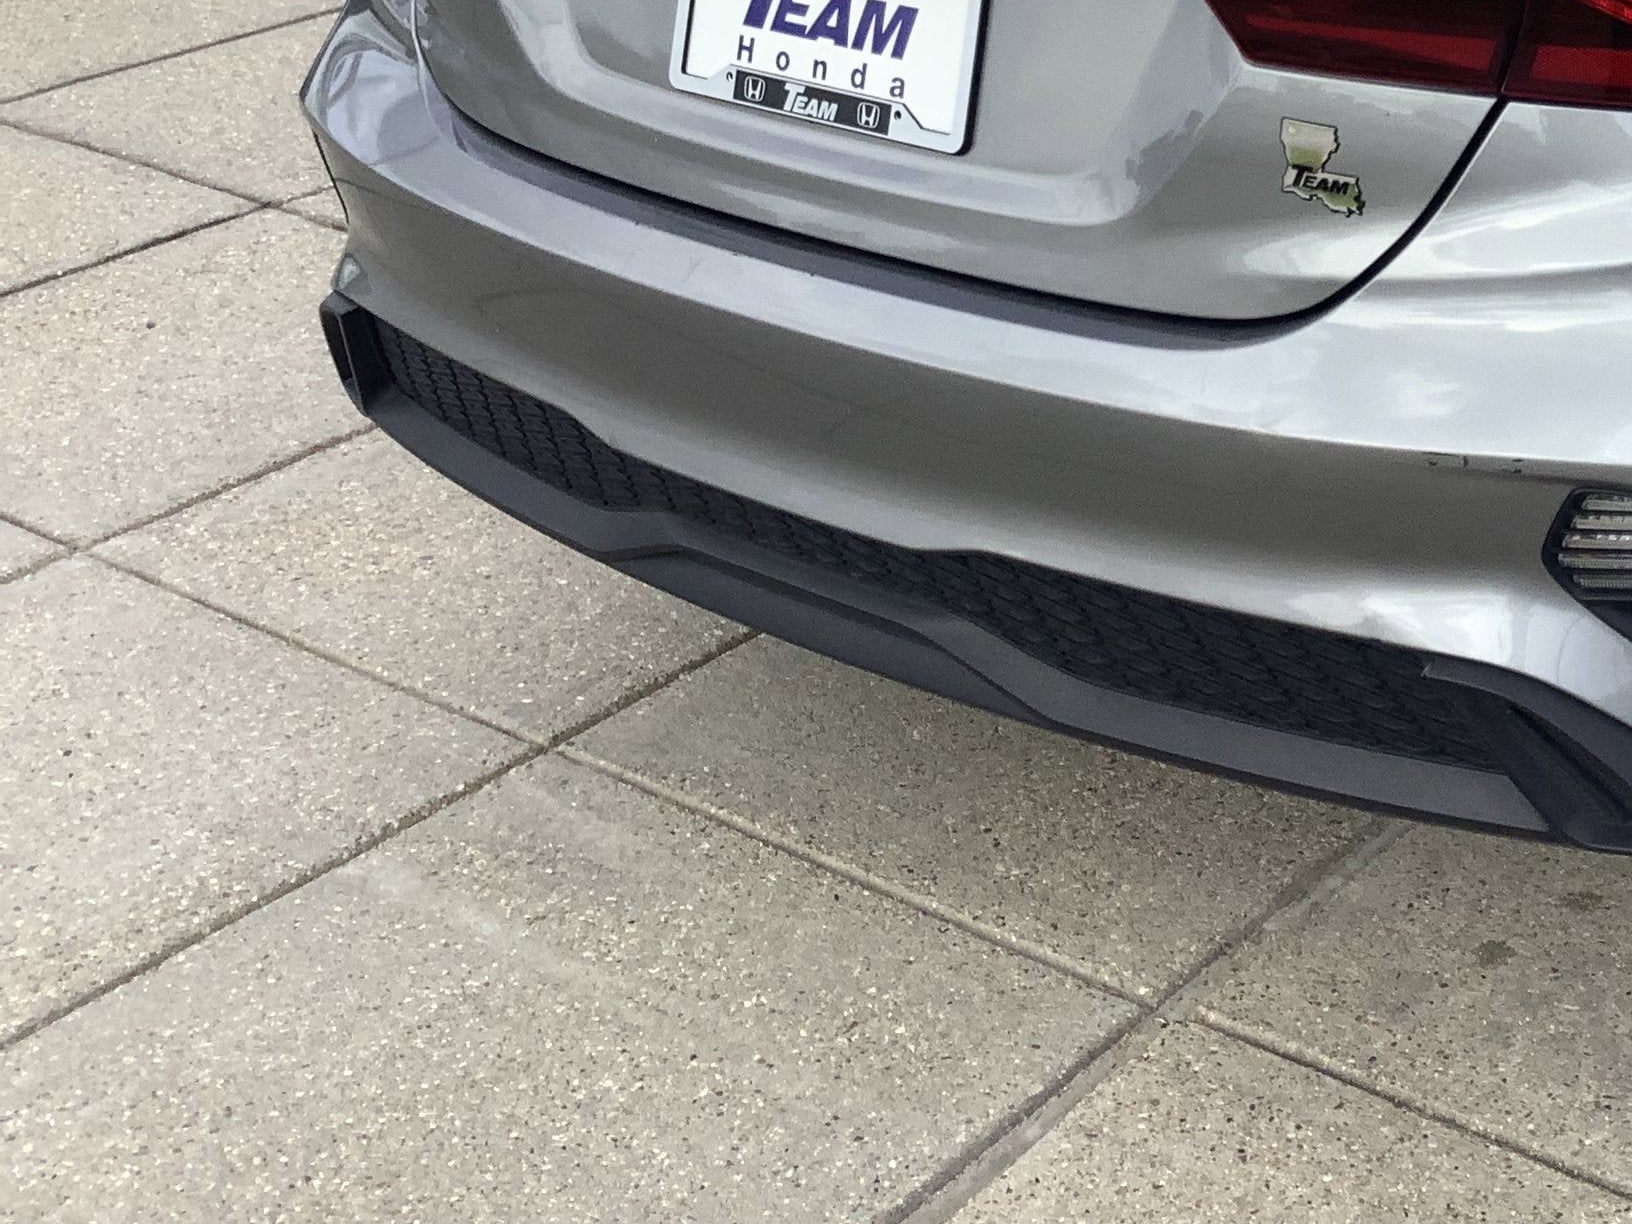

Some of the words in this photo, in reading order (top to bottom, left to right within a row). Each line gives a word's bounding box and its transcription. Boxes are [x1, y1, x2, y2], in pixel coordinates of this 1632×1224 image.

[736, 34, 906, 99] Honda
[783, 83, 838, 121] TEAM
[1291, 164, 1350, 195] TEAM
